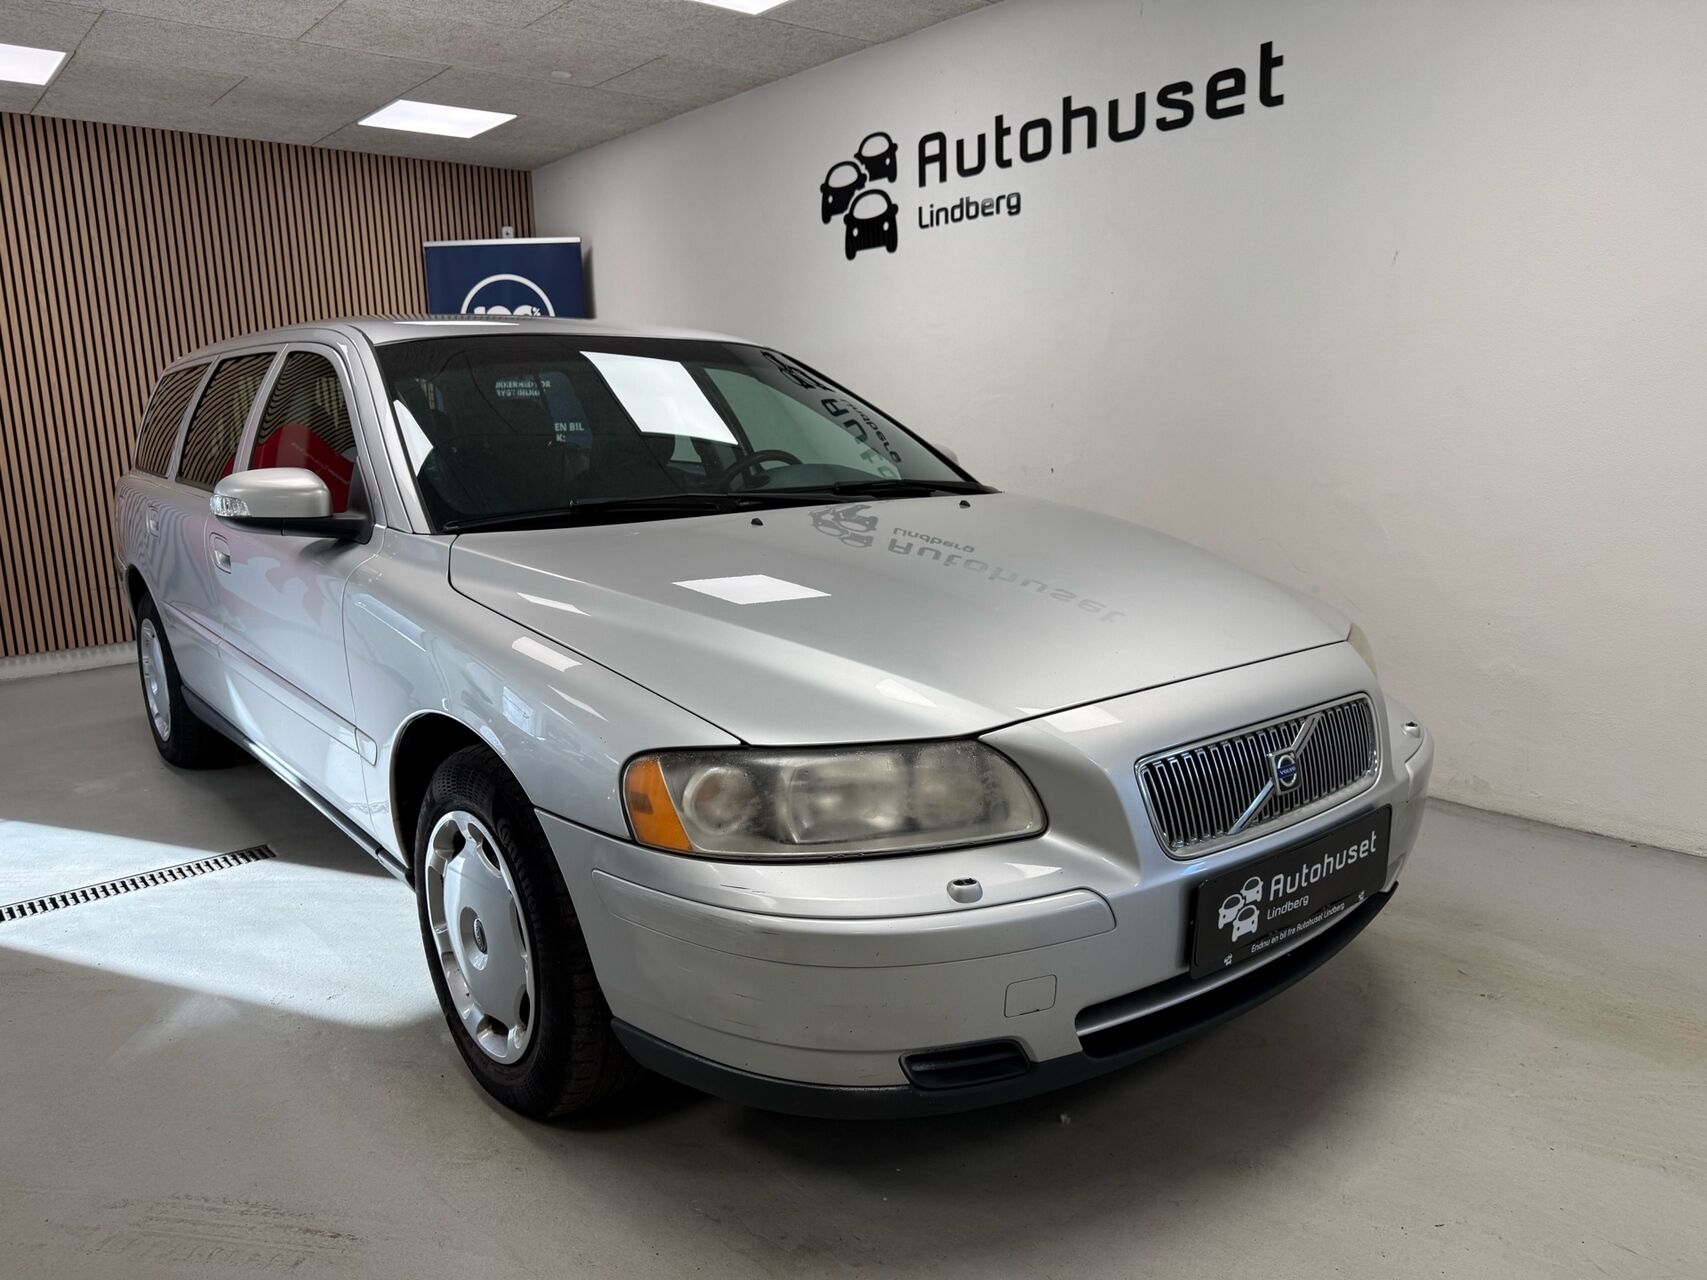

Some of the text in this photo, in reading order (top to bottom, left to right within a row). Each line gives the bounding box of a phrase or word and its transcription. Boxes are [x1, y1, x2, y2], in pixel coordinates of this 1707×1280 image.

[917, 41, 1285, 188] Autohuset
[917, 192, 1022, 229] Lindberg
[569, 422, 584, 431] BIL
[1279, 766, 1296, 775] VOLVO
[1269, 830, 1377, 901] Autohuset
[1267, 895, 1309, 920] Lindberg
[1296, 912, 1324, 931] Autohuset
[1323, 902, 1345, 919] Lindberg
